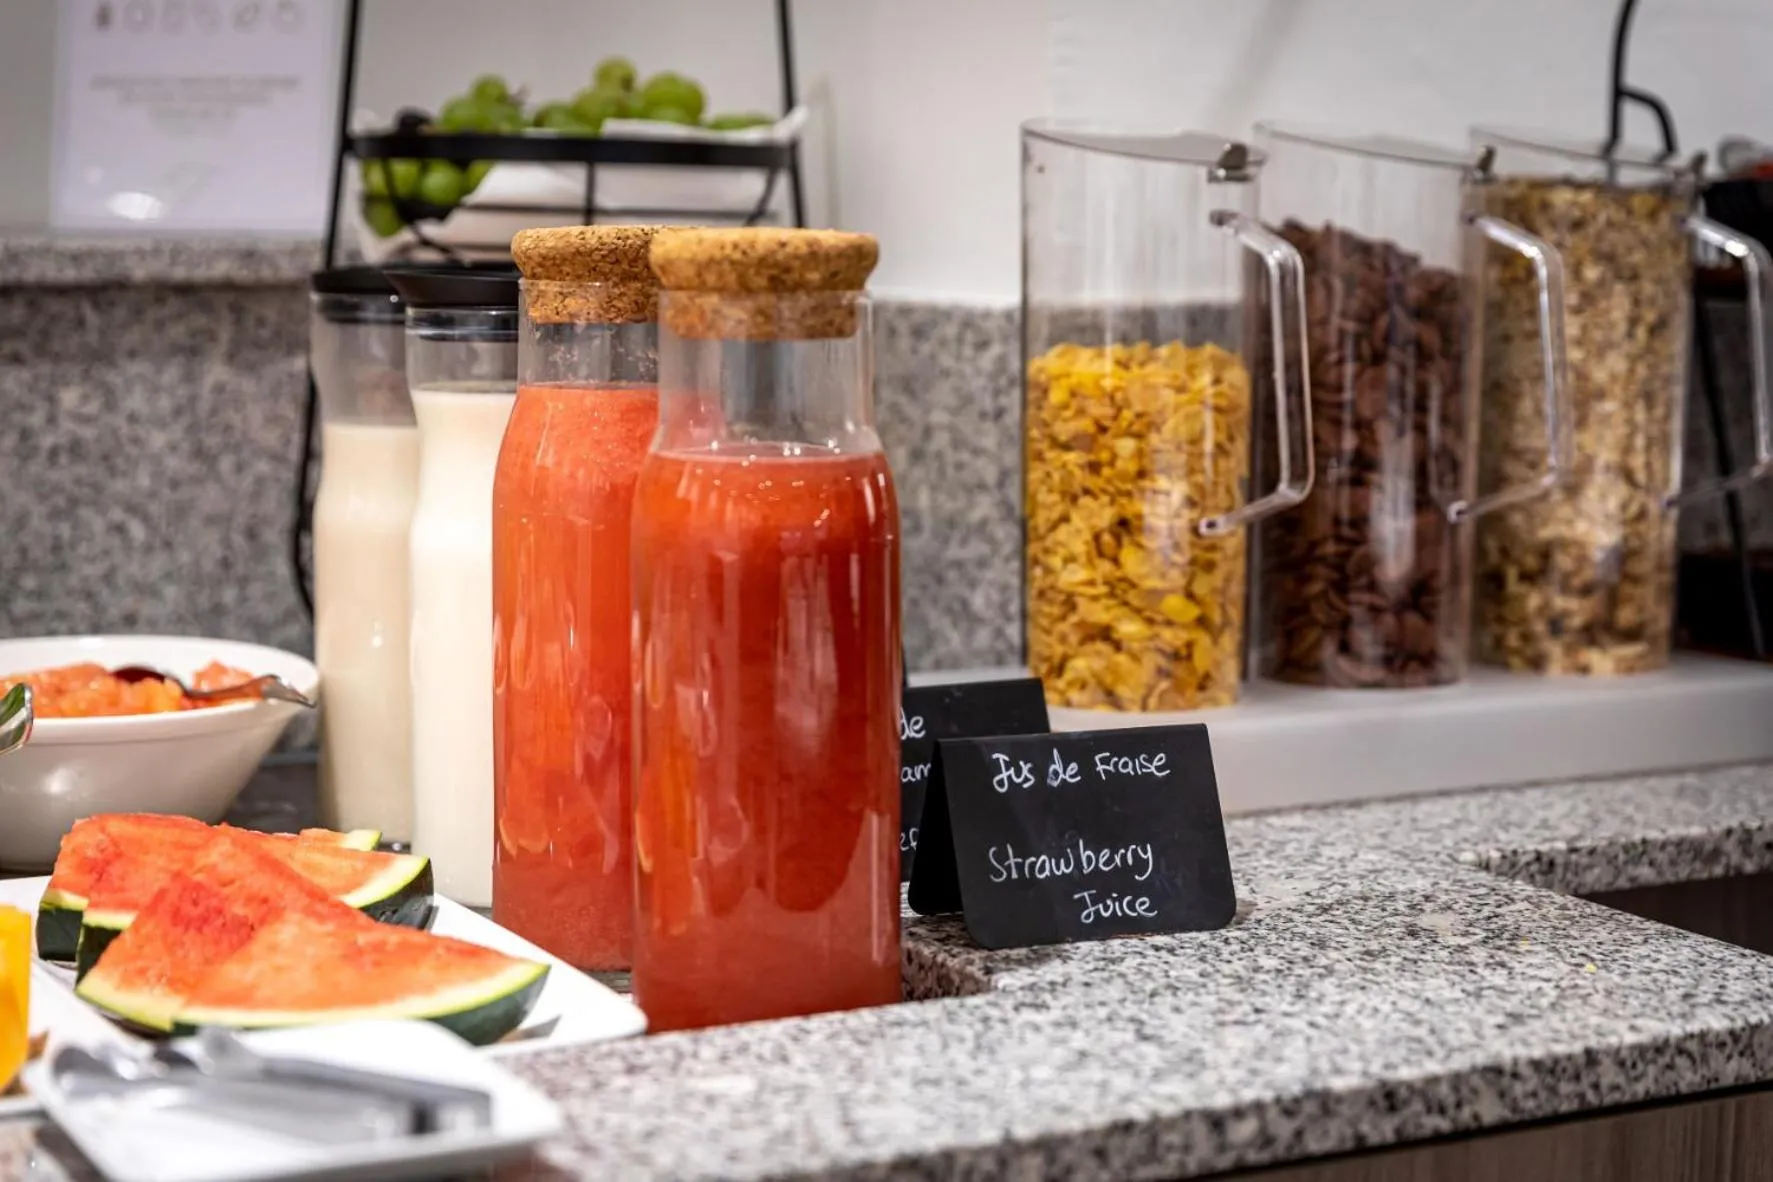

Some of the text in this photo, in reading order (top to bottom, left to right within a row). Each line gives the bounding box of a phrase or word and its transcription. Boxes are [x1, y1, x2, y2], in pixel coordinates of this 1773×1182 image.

[991, 747, 1171, 793] Jus de Fraise
[989, 838, 1154, 882] Strawberry
[1073, 889, 1158, 924] Juice
